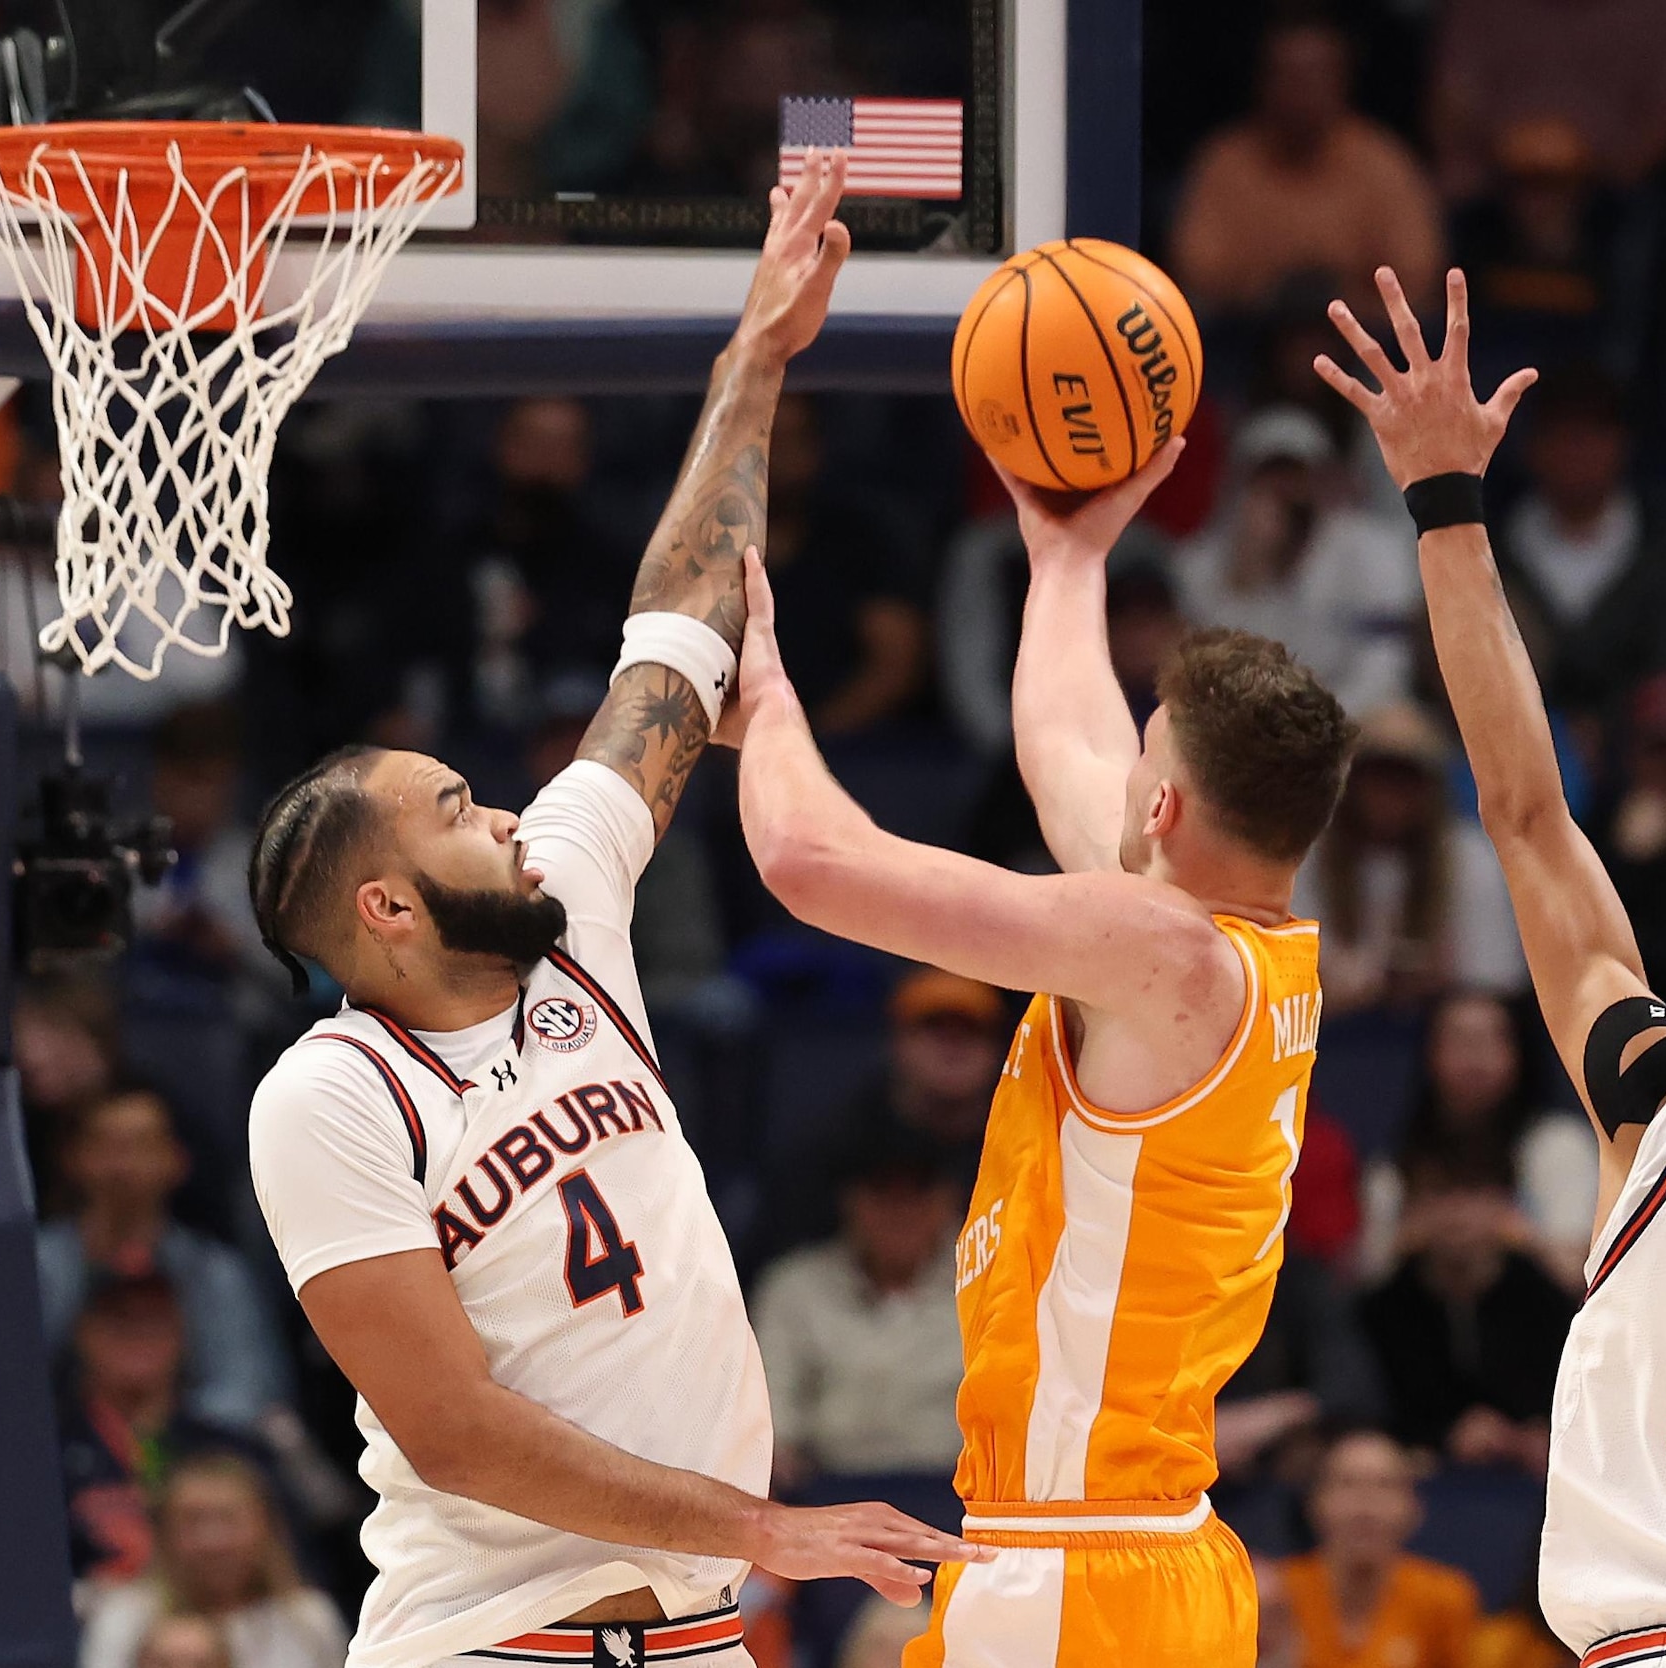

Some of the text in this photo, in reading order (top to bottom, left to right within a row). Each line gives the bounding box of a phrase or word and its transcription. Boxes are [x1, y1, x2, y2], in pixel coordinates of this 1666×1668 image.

[550, 1015, 596, 1053] GRADUATE
[433, 1080, 666, 1273] AUBURN
[556, 1167, 645, 1319] 4
